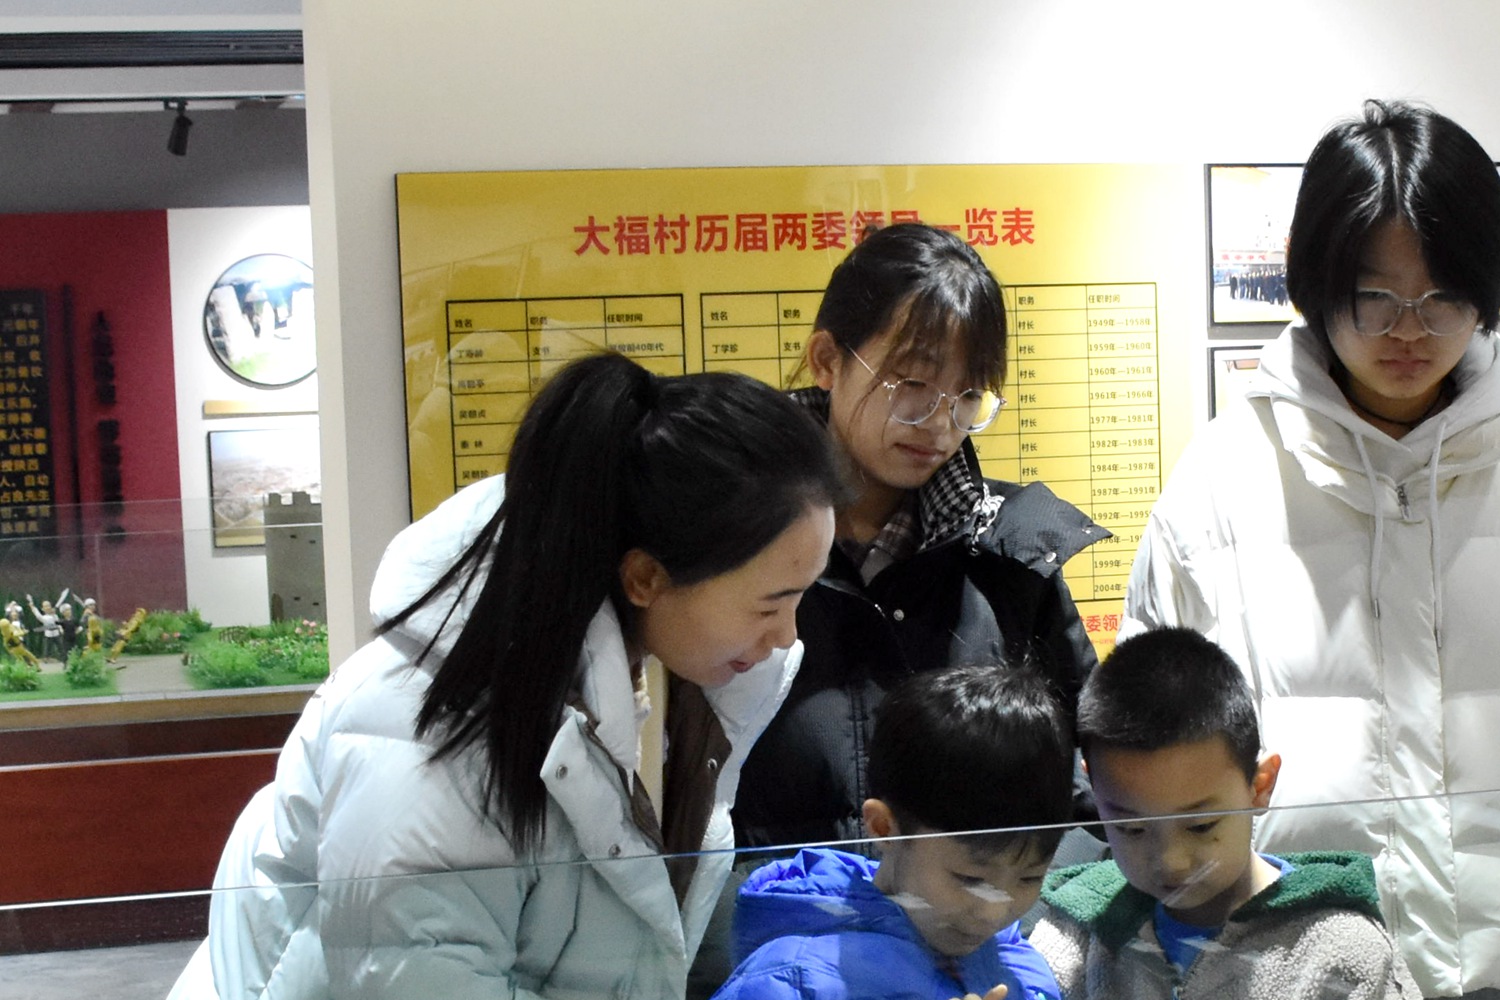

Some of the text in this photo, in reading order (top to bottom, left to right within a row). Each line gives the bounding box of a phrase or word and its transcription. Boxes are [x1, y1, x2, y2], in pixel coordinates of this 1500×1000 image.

[1018, 296, 1035, 305] 职务
[1088, 294, 1121, 303] 任职时间
[711, 311, 728, 321] 姓名
[783, 309, 801, 319] 职务
[1018, 320, 1034, 330] 村长
[783, 342, 801, 352] 支书
[1019, 345, 1035, 354] 村长
[1019, 369, 1036, 379] 村长
[1020, 393, 1036, 403] 村长
[1020, 418, 1037, 428] 村长
[1021, 443, 1037, 453] 村长
[1022, 467, 1038, 477] 村长
[1093, 510, 1152, 520] 1992年—1995
[1080, 614, 1123, 633] 委领
